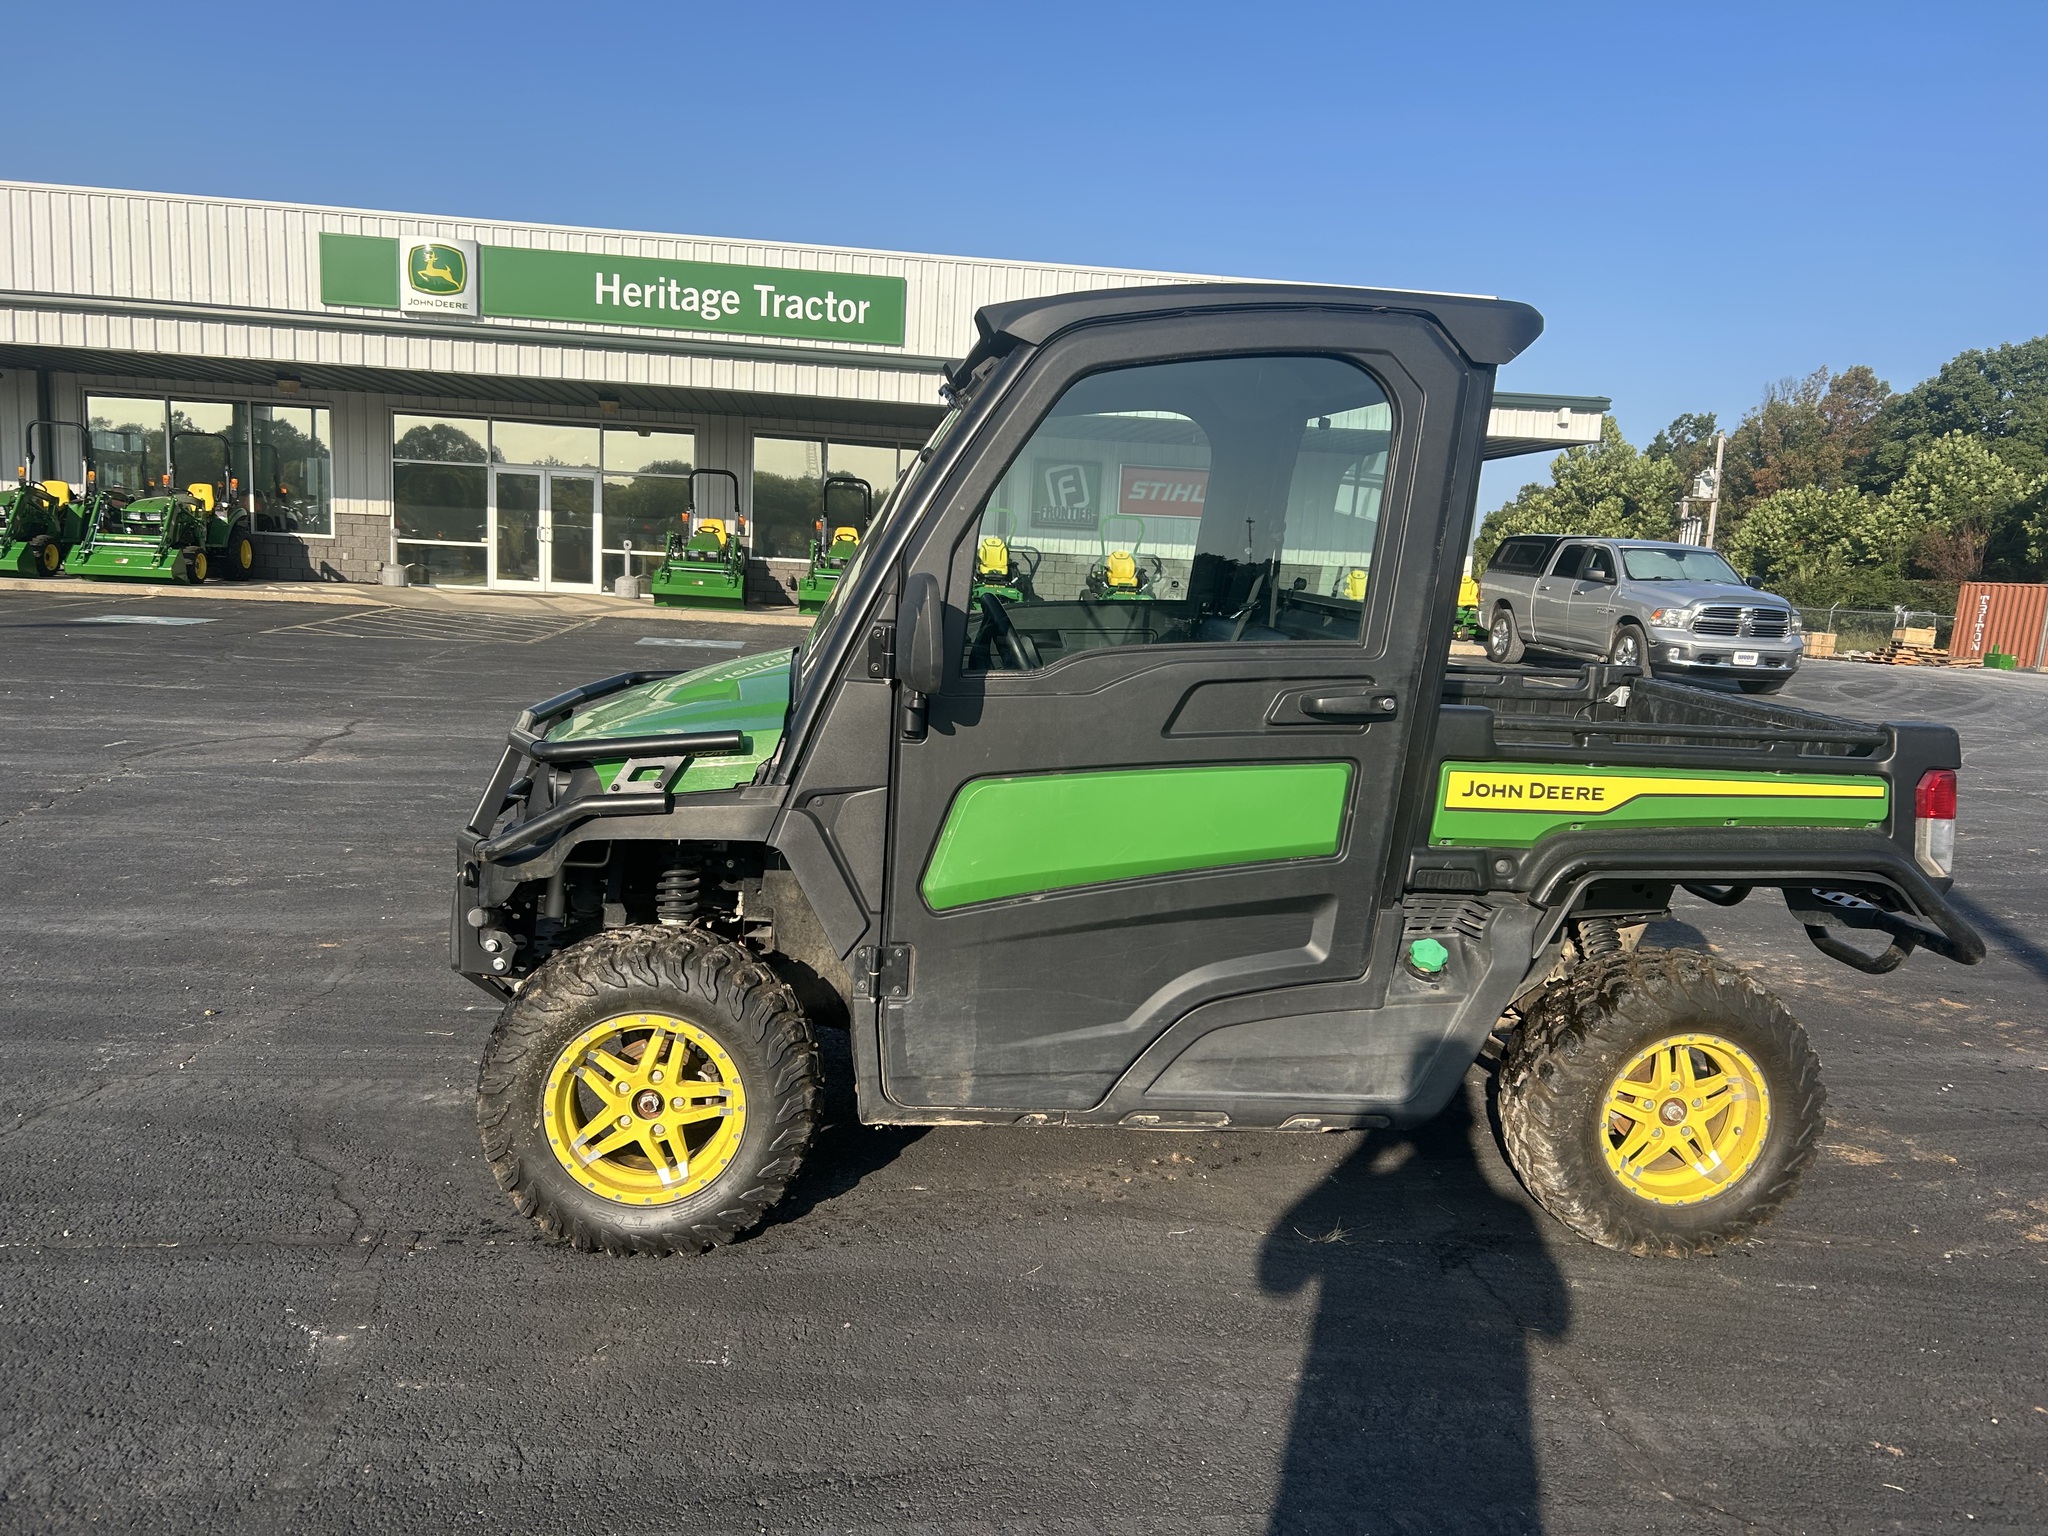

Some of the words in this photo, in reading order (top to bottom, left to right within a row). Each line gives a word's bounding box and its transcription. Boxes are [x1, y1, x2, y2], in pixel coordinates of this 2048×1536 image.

[407, 297, 434, 307] JOHN
[435, 299, 469, 310] DEERE
[595, 272, 741, 321] Heritage
[753, 284, 871, 325] Tractor
[1127, 480, 1206, 503] STIHL
[1039, 505, 1093, 523] FRONTIER
[1970, 595, 1991, 651] TRITON
[1461, 780, 1524, 799] JOHN
[1529, 782, 1605, 801] DEERE
